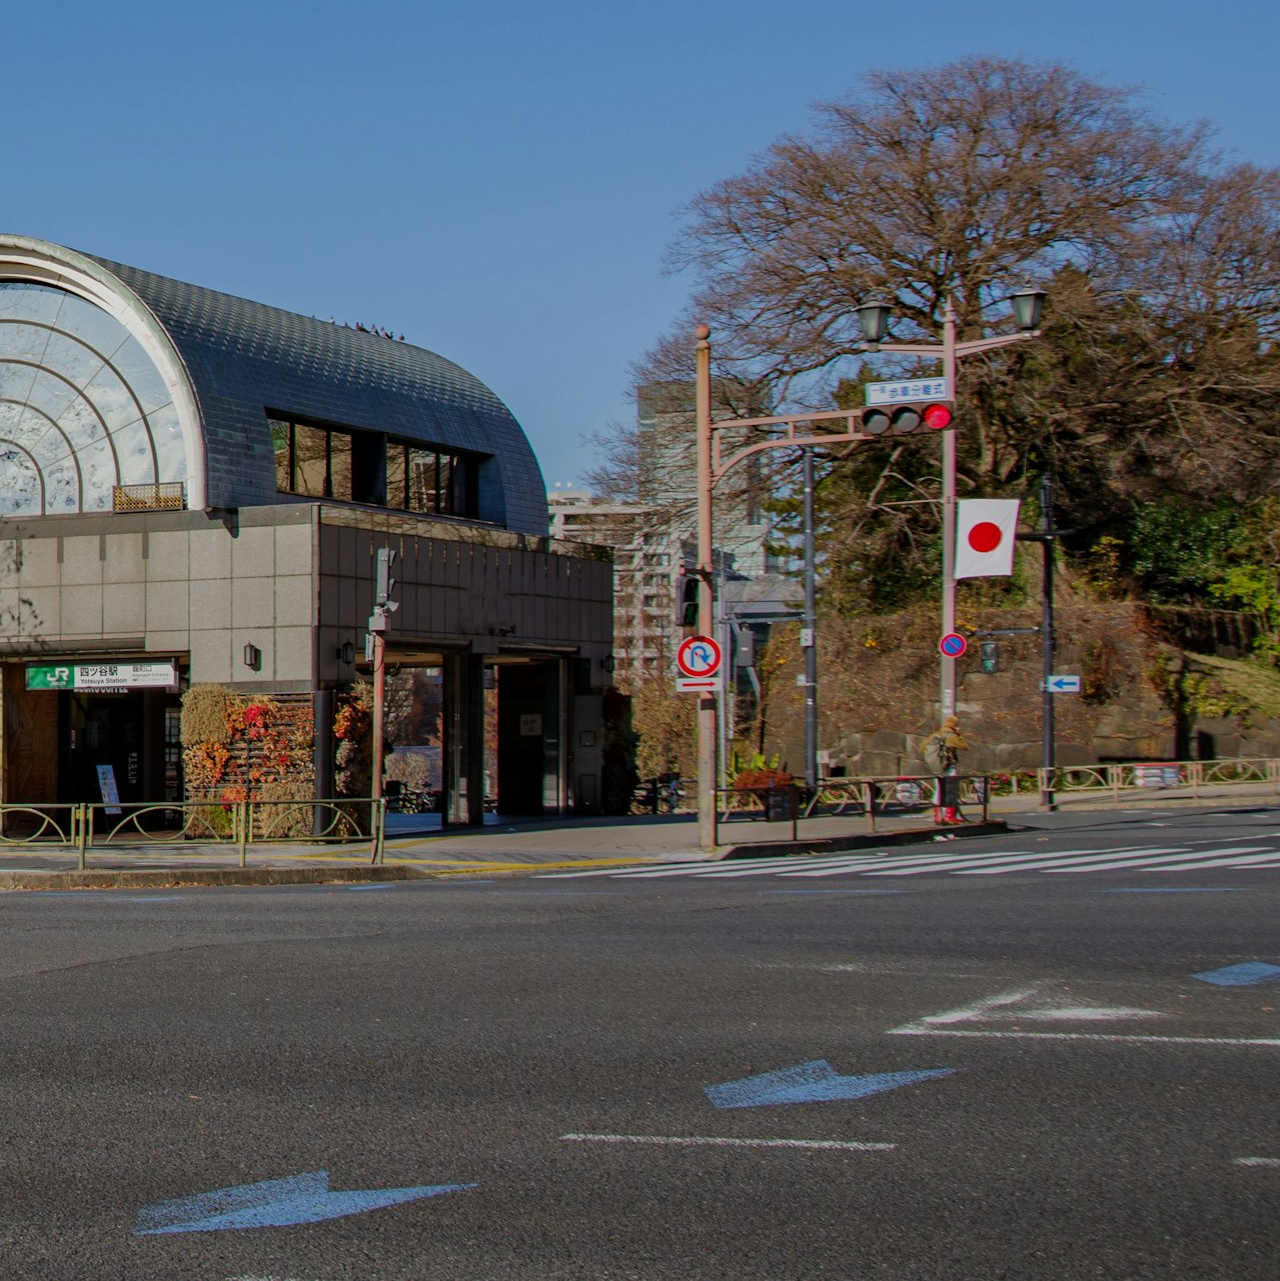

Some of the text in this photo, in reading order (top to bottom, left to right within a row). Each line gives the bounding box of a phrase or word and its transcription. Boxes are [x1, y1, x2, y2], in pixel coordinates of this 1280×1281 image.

[46, 667, 70, 682] JR
[80, 666, 118, 677] 四ツ谷駅
